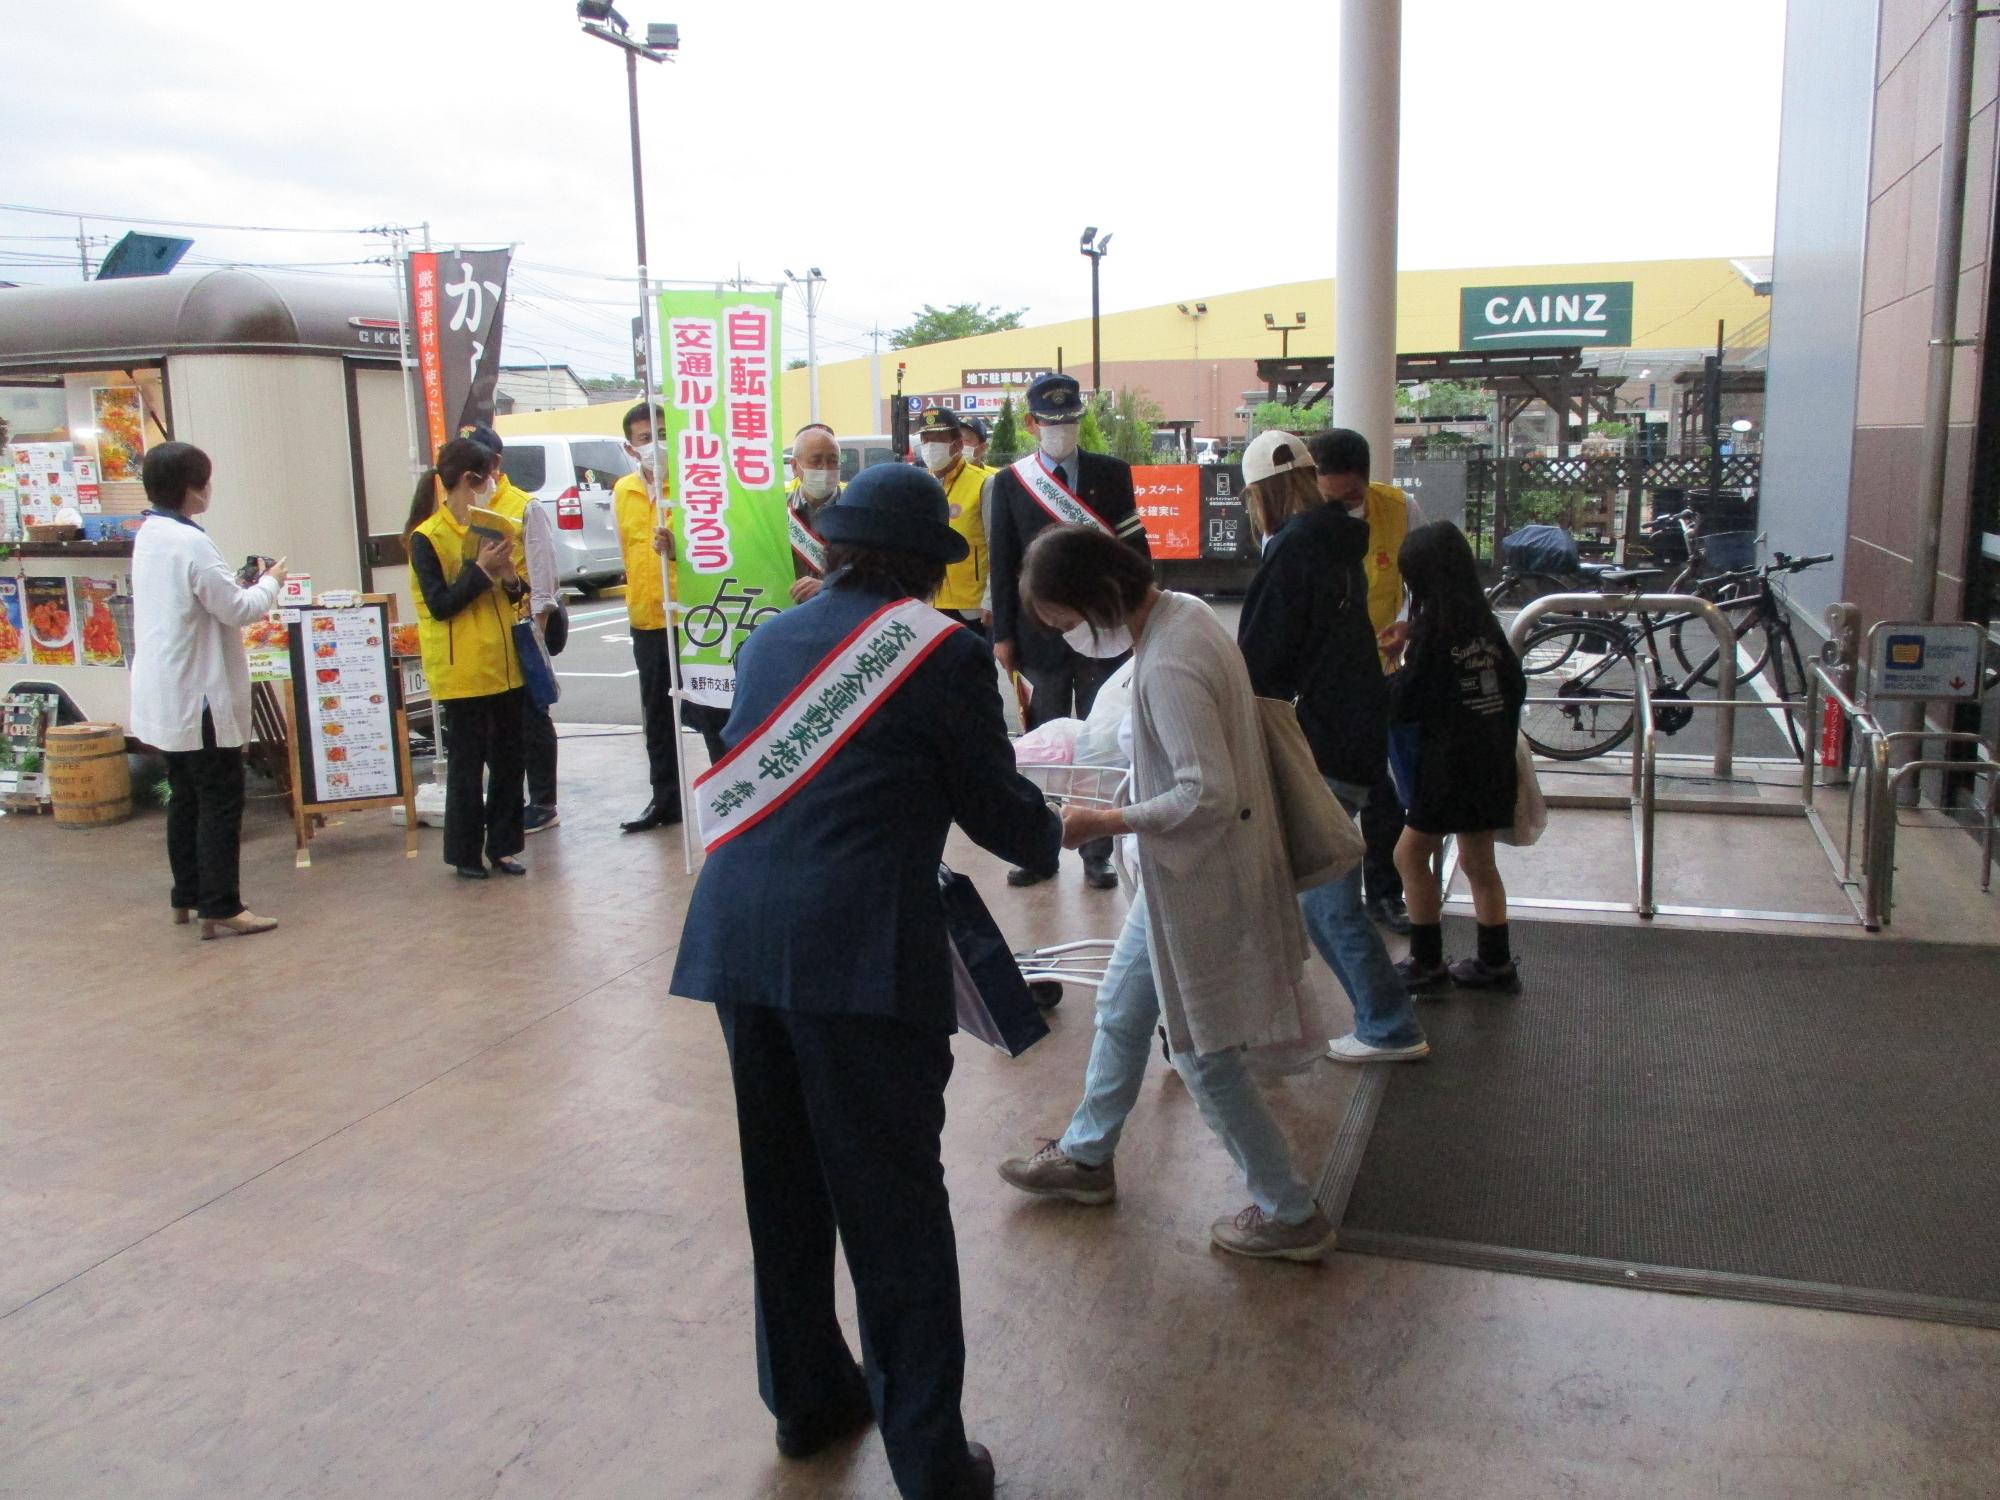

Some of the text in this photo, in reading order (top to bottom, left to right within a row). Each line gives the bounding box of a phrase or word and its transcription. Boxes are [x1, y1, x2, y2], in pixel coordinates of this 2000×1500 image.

[1485, 294, 1607, 325] CAINZ
[728, 310, 770, 486] 自転車も
[673, 323, 728, 569] 交通ルールを守ろう
[1148, 484, 1184, 495] スタート
[1136, 506, 1181, 517] を確実に
[757, 619, 918, 781] 交通安全運動実施中
[710, 778, 758, 818] 秦野市
